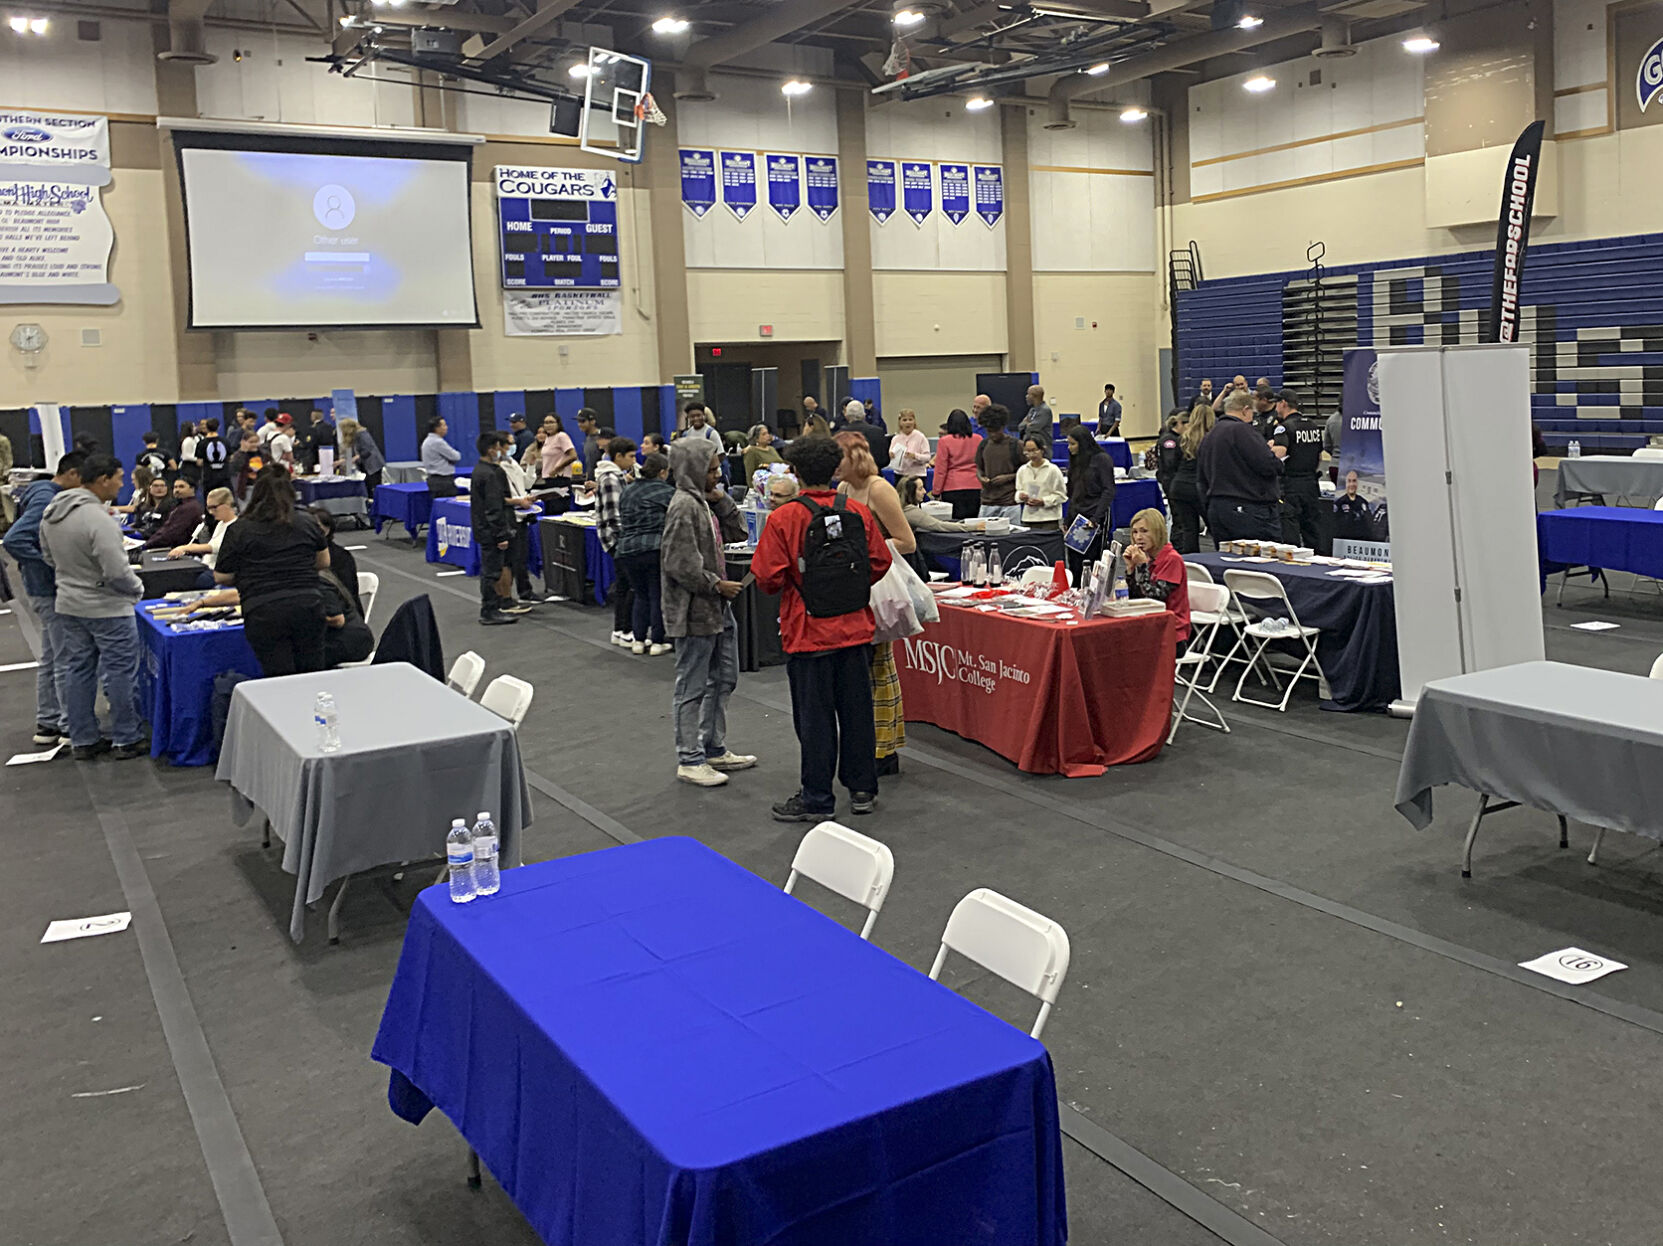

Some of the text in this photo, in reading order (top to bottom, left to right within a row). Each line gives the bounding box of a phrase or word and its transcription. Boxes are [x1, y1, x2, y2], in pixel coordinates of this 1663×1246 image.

[45, 118, 96, 128] SECTION
[12, 129, 44, 141] Ford
[500, 168, 585, 181] HOME OF THE
[499, 179, 595, 196] COUGARS
[507, 222, 613, 234] HOME GUEST
[550, 227, 572, 235] PERIOD
[542, 254, 564, 262] PLAYER
[567, 255, 582, 263] FOUL
[599, 255, 618, 263] FOULS
[1296, 429, 1320, 444] POLICE
[903, 637, 1030, 685] MSJC Mt. San Jacinto
[958, 666, 996, 694] College
